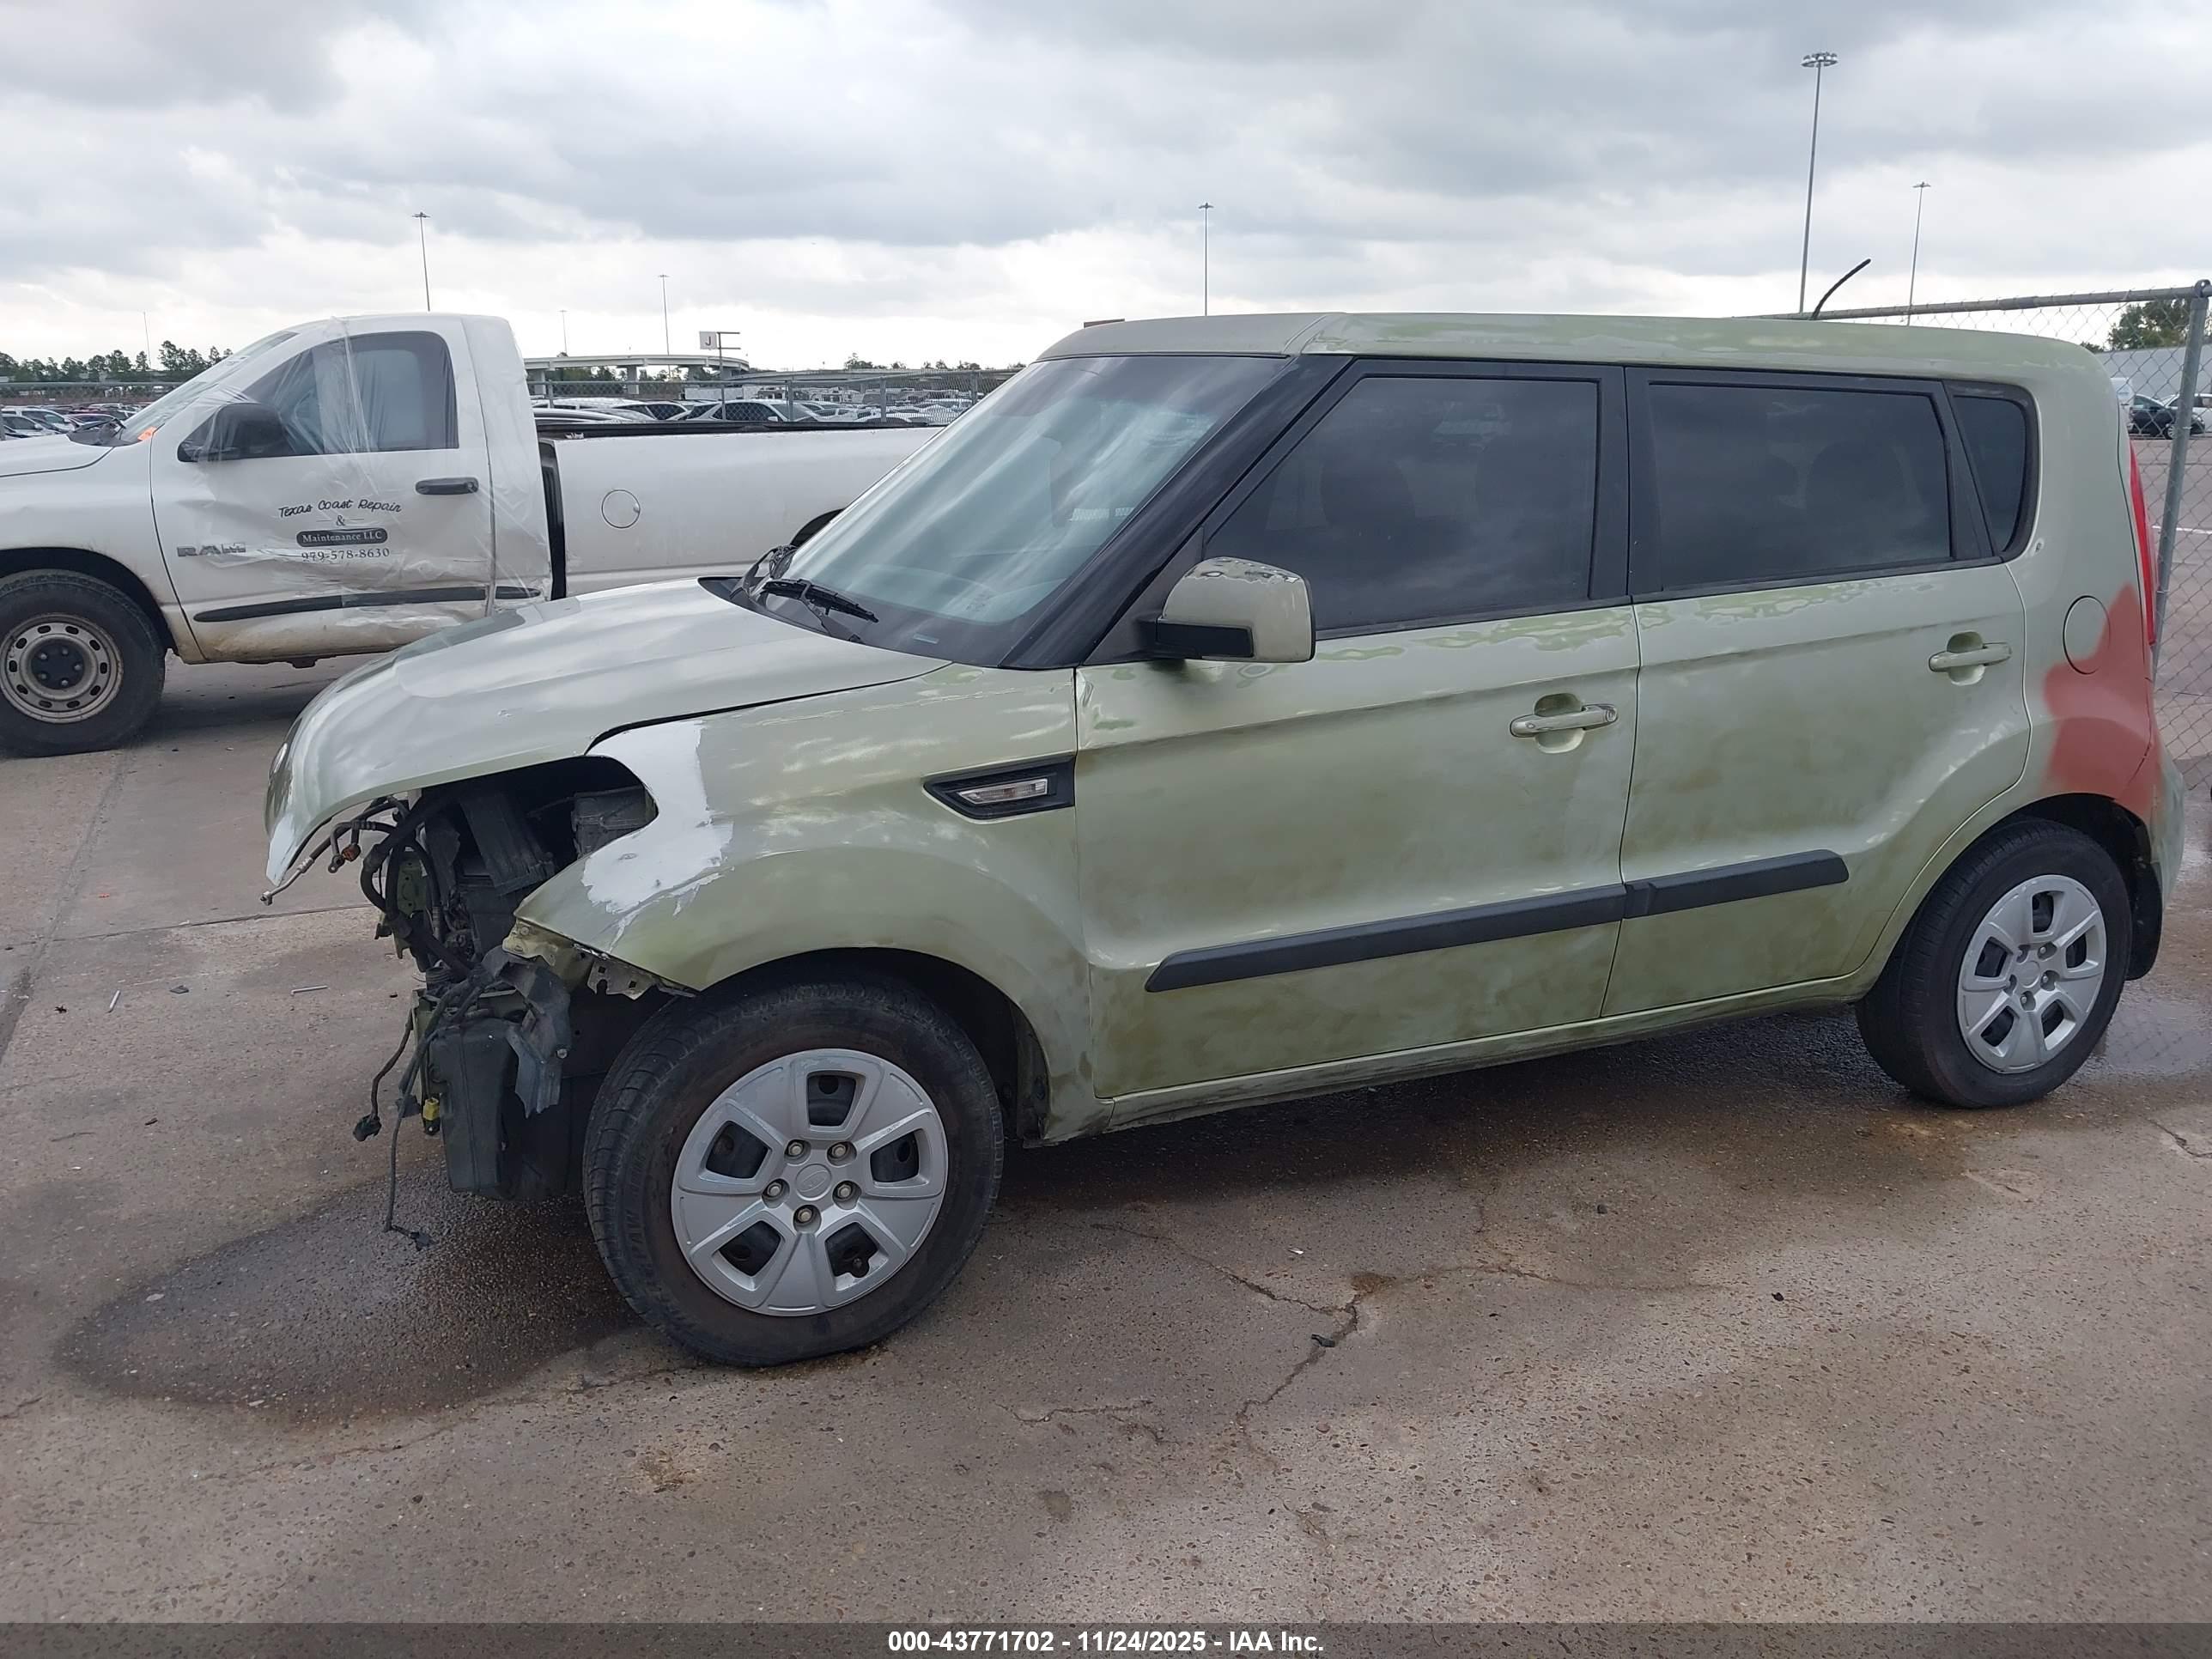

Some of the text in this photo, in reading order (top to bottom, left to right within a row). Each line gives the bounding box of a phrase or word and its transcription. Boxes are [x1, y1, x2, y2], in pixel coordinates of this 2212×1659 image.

[704, 336, 712, 346] J
[278, 498, 402, 518] Texas Coast Repair
[336, 514, 345, 526] &
[301, 530, 383, 544] Maintenance LLC
[301, 547, 390, 562] 979-578-8630
